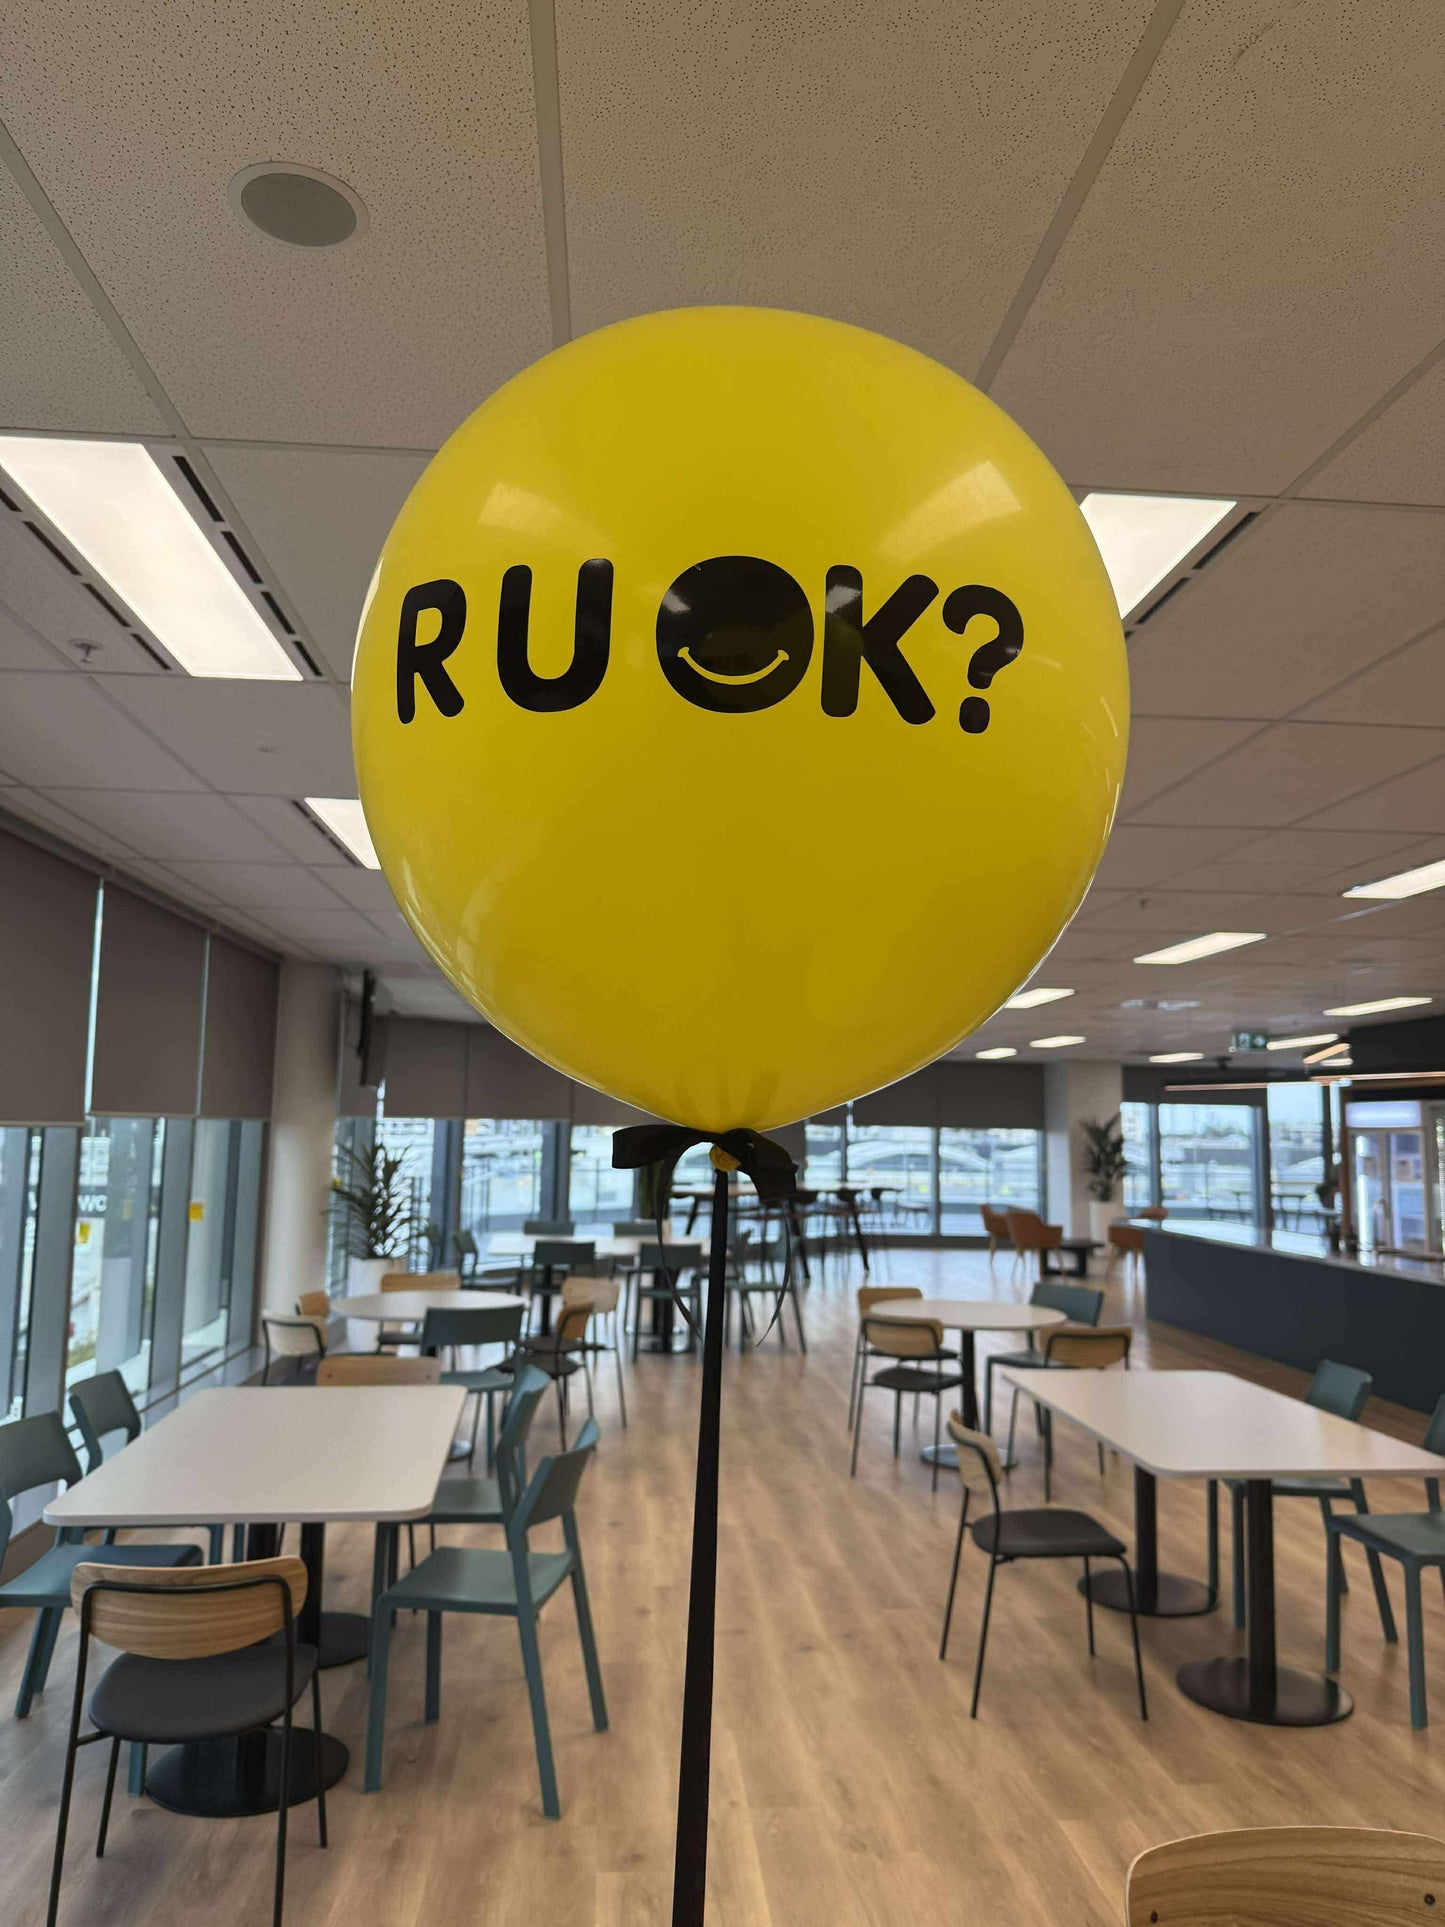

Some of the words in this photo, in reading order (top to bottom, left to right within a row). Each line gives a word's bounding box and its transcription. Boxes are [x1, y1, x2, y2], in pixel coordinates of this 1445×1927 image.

[396, 578, 467, 725] R
[496, 558, 614, 713] U
[655, 555, 1025, 734] OK?
